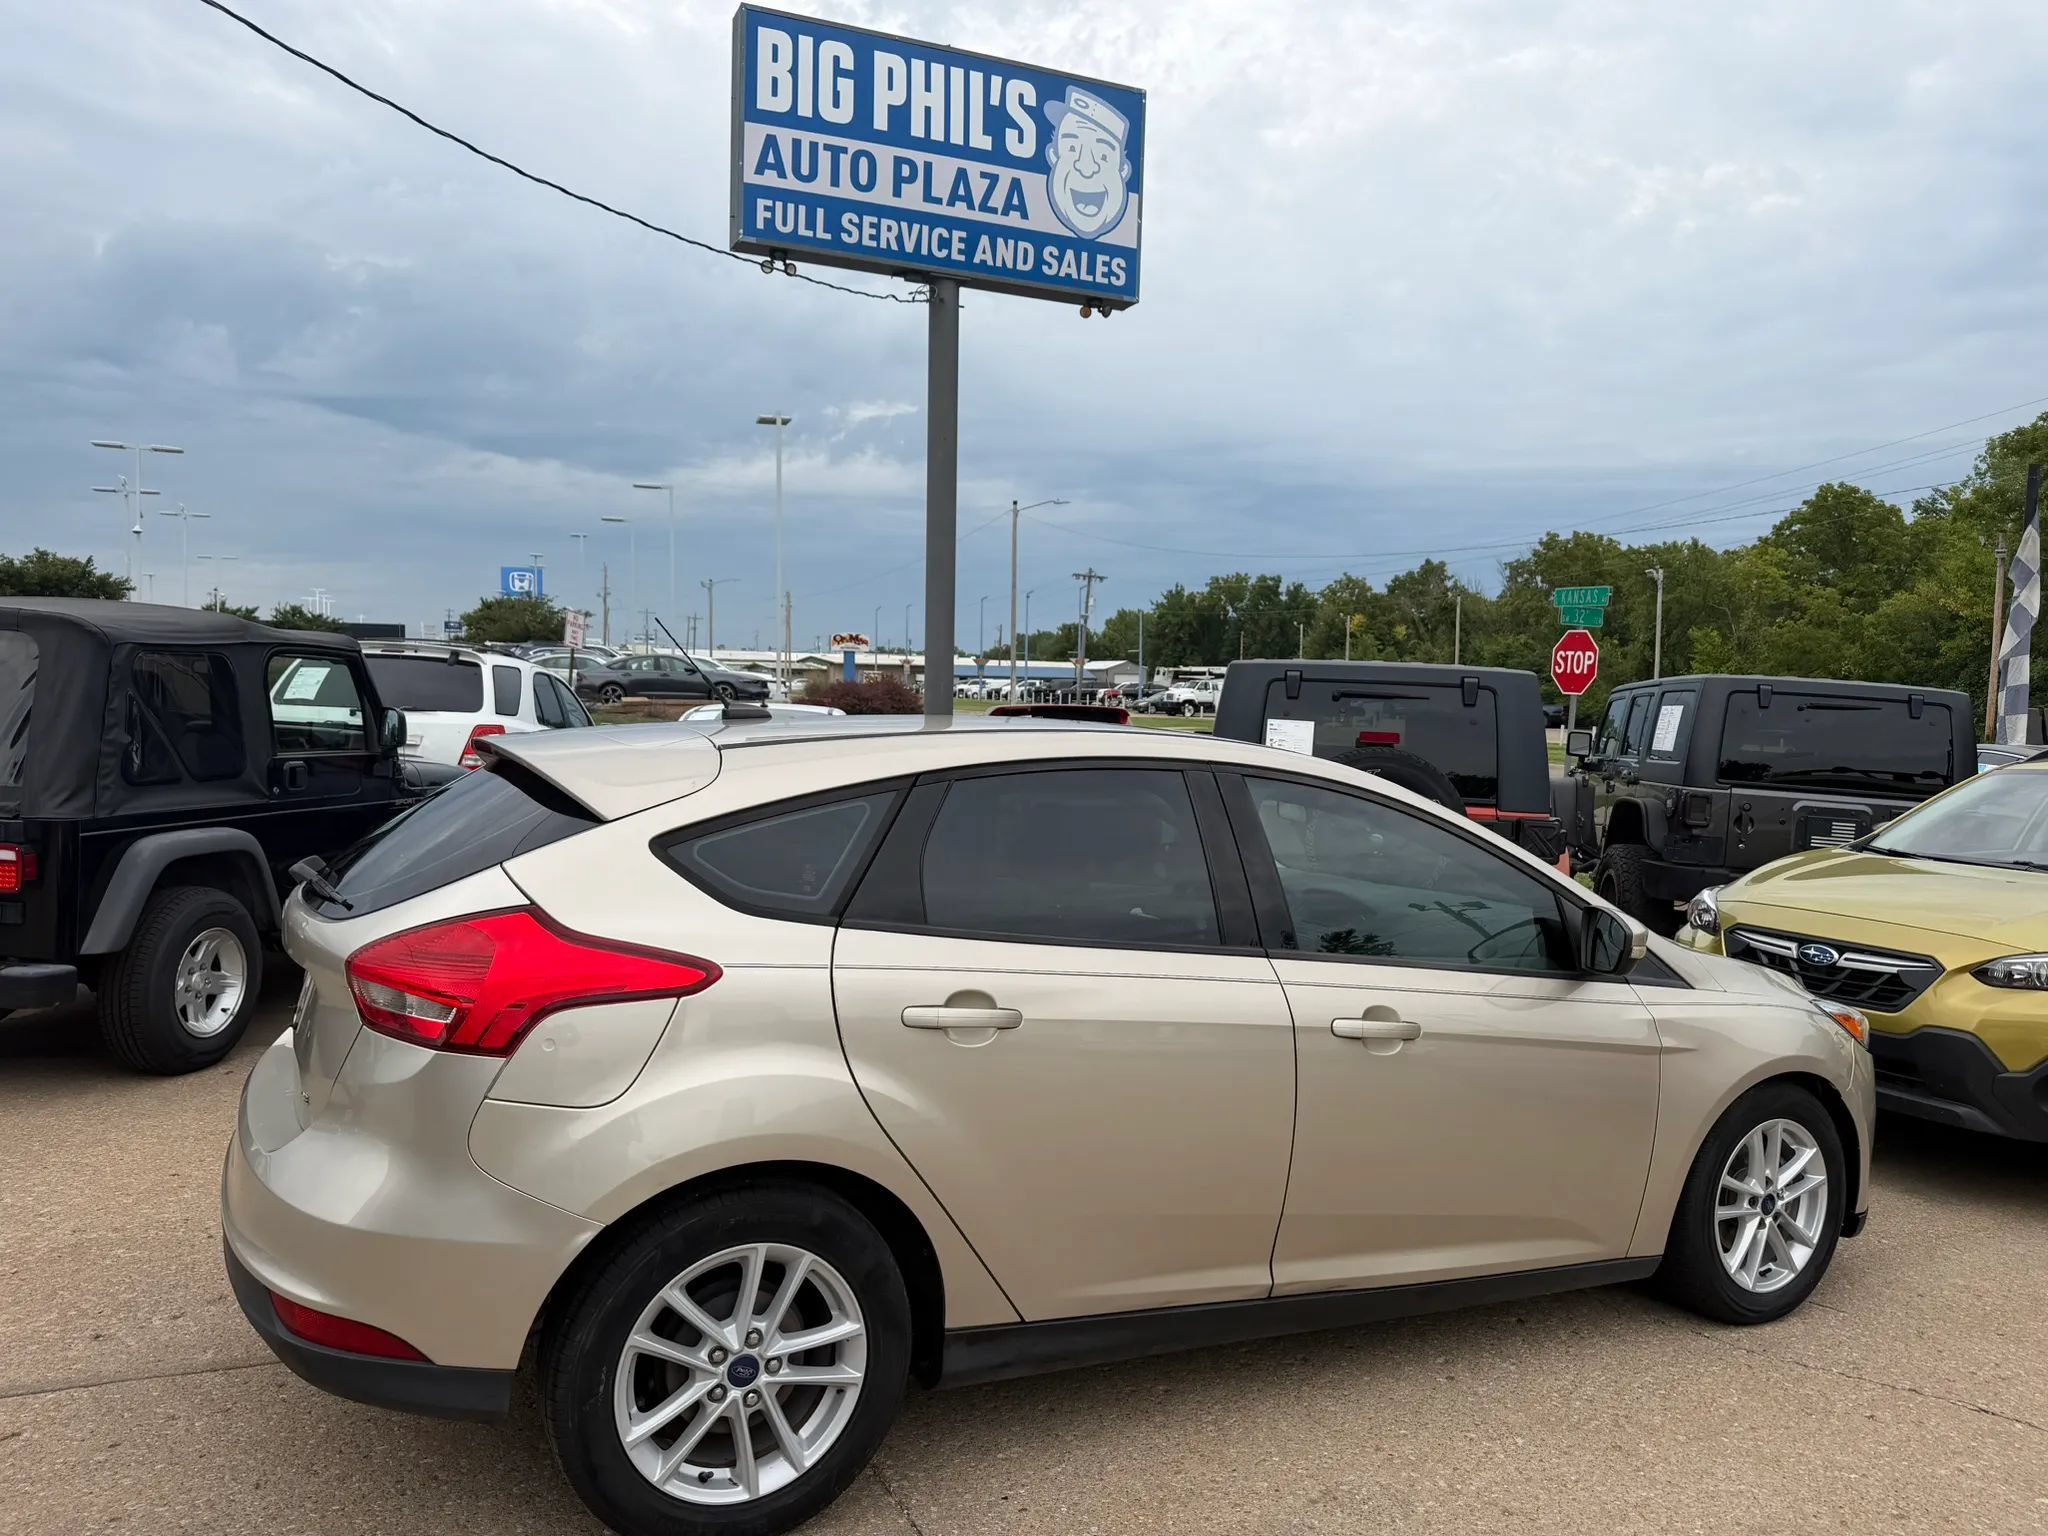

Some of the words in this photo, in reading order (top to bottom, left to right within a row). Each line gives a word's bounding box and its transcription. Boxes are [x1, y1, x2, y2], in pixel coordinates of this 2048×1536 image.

[756, 26, 855, 125] BIG
[873, 50, 1037, 159] PHIL'S
[754, 133, 877, 194] AUTO
[892, 155, 1030, 221] PLAZA
[756, 197, 832, 241] FULL
[840, 214, 967, 262] SERVICE
[973, 238, 1034, 272] AND
[1042, 248, 1126, 286] SALES
[1561, 589, 1599, 604] KANSAS
[1555, 650, 1595, 675] STOP
